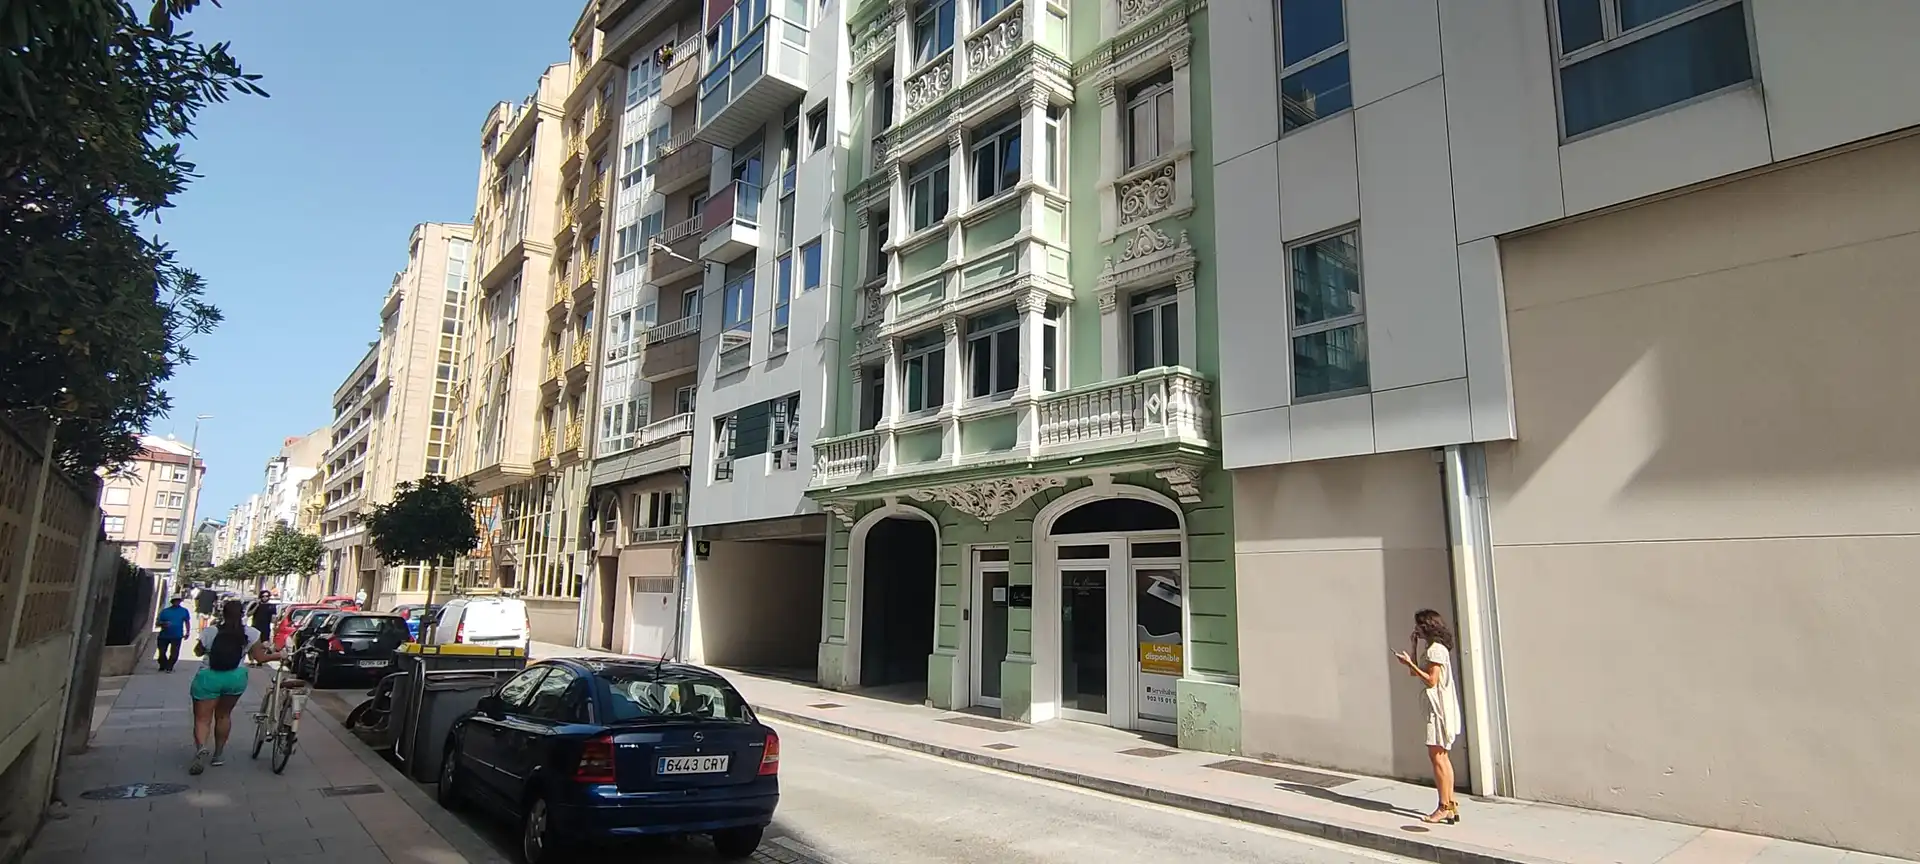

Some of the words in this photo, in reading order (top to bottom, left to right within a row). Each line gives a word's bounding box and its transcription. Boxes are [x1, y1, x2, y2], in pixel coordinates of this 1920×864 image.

[1152, 644, 1172, 653] Local
[1145, 652, 1180, 662] disponible
[666, 758, 698, 772] 6443
[703, 757, 726, 771] CRY
